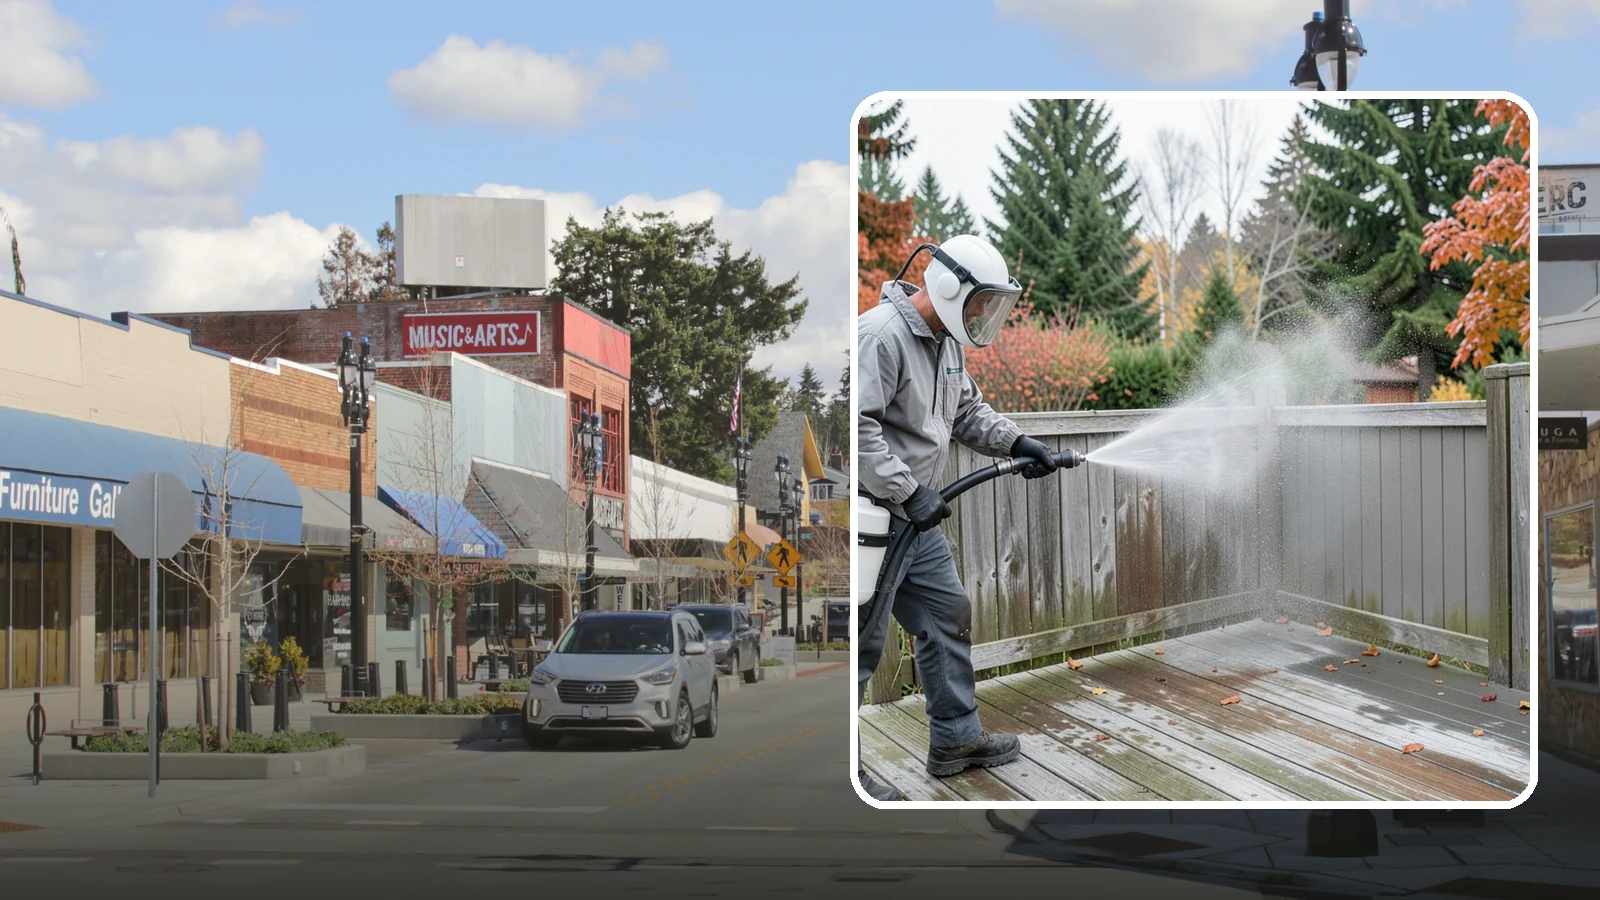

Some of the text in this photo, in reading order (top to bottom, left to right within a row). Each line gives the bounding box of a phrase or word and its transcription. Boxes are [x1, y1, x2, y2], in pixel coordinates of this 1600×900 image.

[1540, 427, 1577, 436] UGA
[0, 472, 122, 519] Furniture Gal
